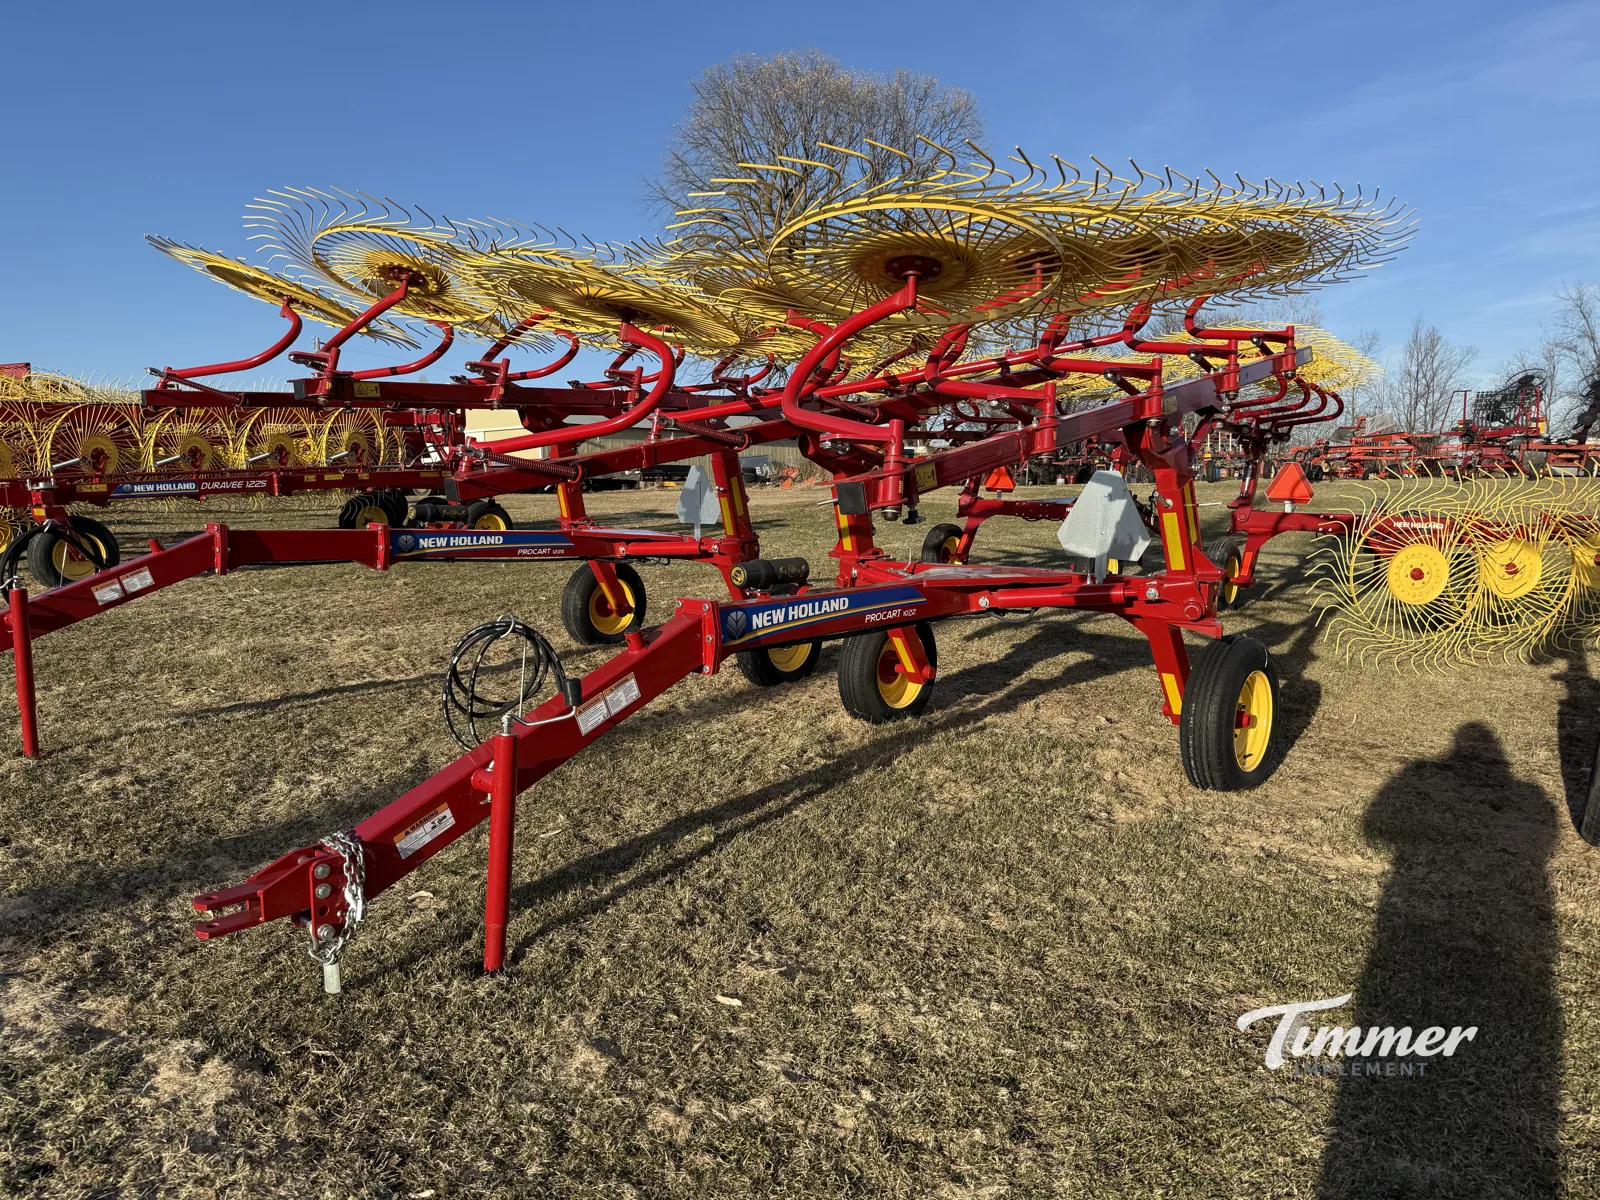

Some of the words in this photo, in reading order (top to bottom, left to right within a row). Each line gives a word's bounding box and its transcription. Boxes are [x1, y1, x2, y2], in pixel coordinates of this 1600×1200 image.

[133, 483, 154, 492] NEW
[156, 482, 196, 491] HOLLAND
[201, 481, 243, 489] DURAVEE
[245, 480, 267, 488] 1225
[419, 536, 447, 548] NEW
[450, 535, 503, 546] HOLLAND
[752, 607, 786, 630] NEW
[788, 597, 849, 621] HOLLAND
[864, 609, 902, 624] PROCART
[902, 608, 917, 617] 1022
[410, 810, 439, 831] WARNING
